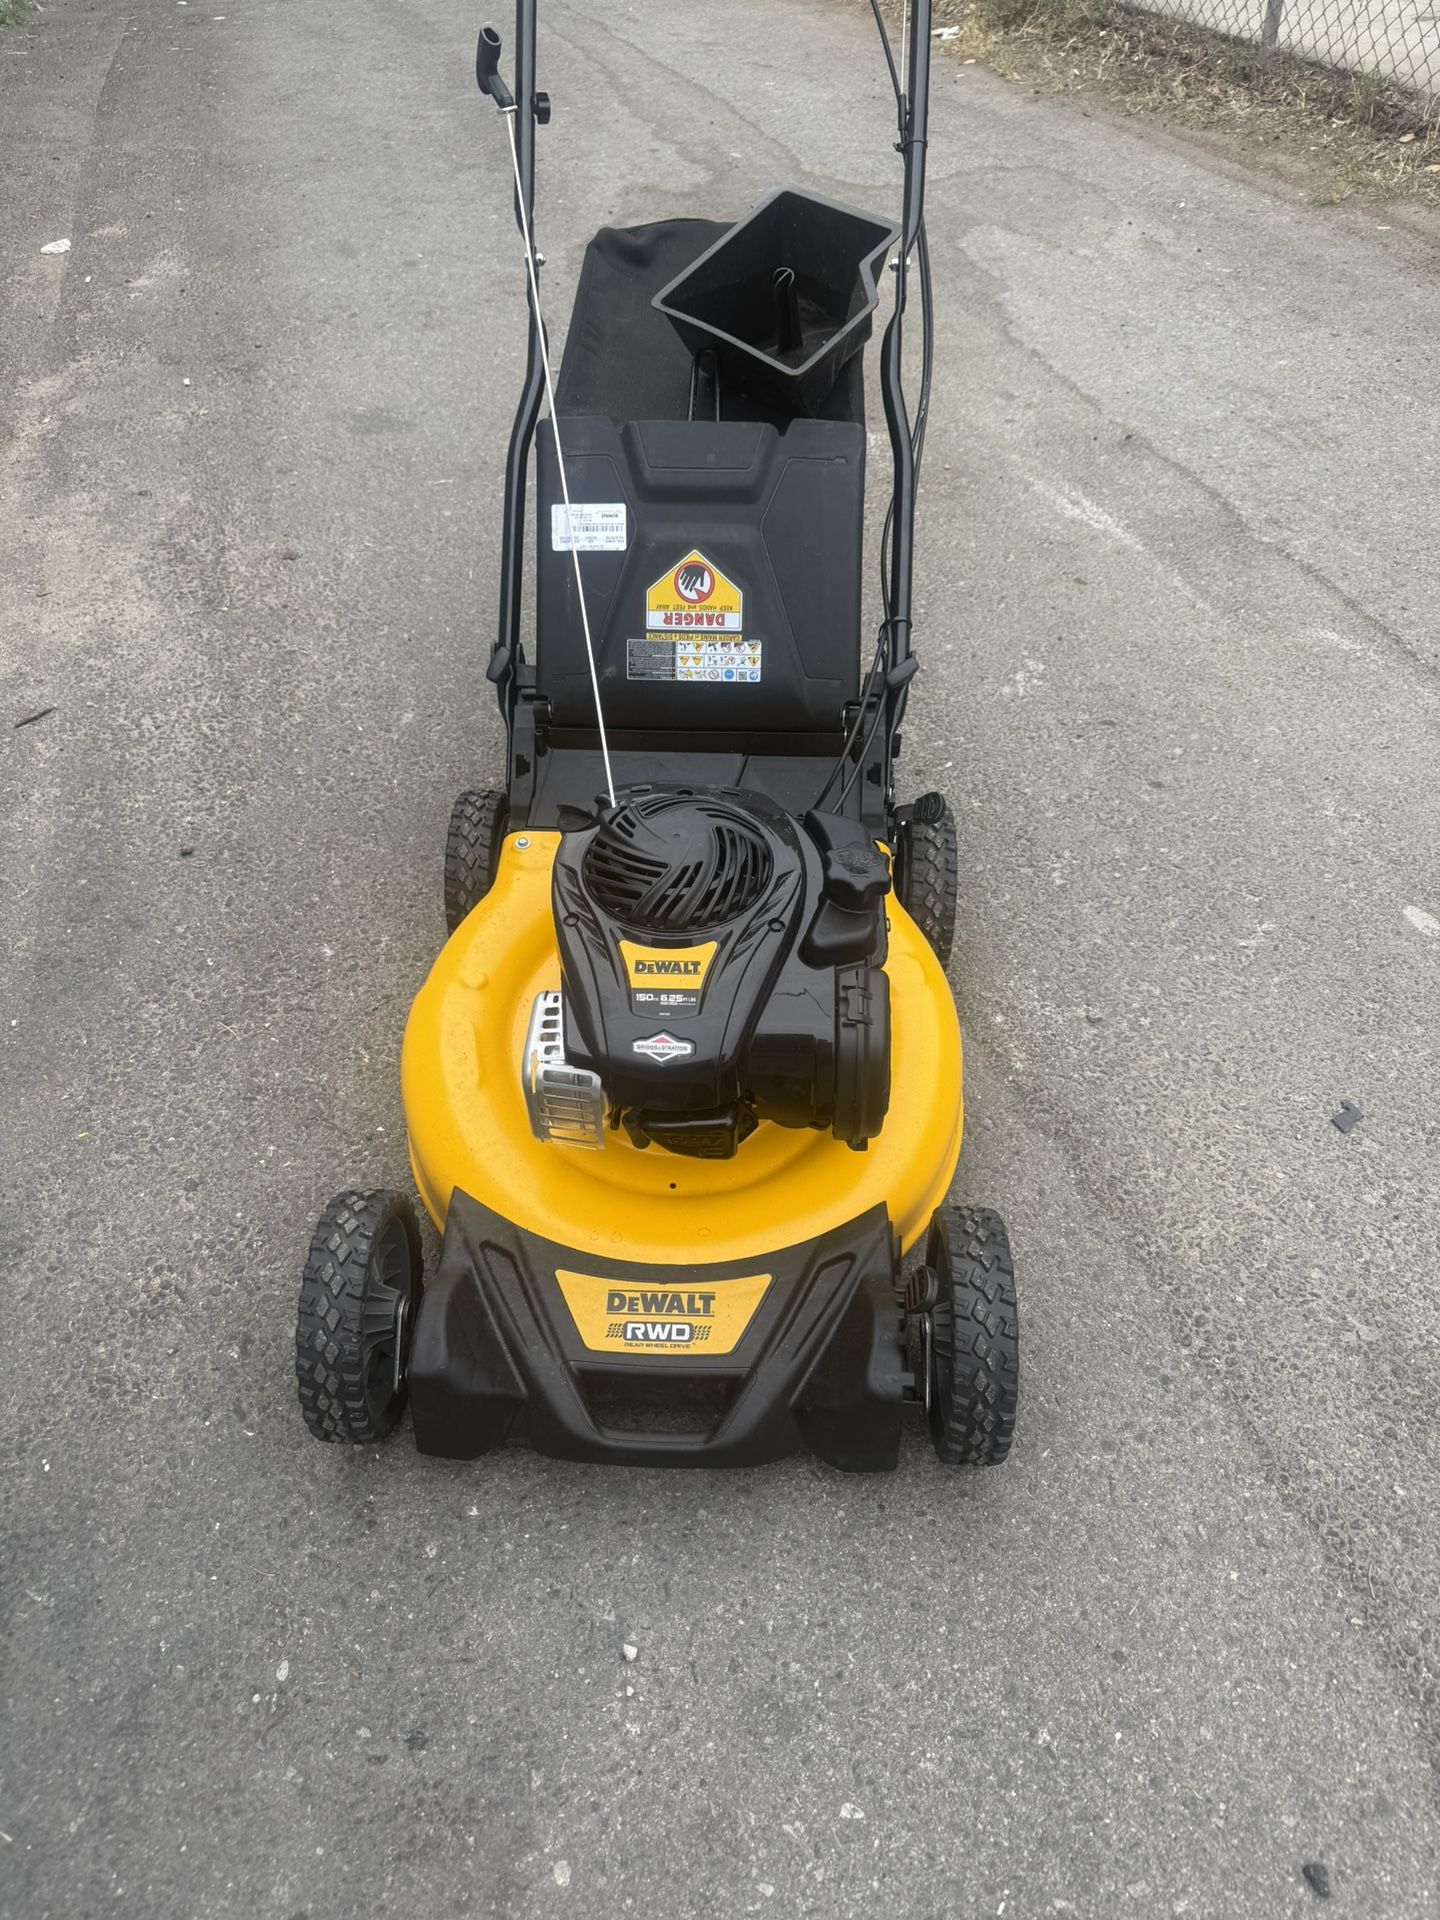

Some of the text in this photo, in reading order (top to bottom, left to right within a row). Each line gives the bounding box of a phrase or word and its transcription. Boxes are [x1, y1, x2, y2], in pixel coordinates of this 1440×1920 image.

[663, 612, 725, 626] DANGER
[634, 960, 700, 974] DeWALT
[606, 1290, 716, 1317] DeWALT
[626, 1323, 691, 1340] RWD
